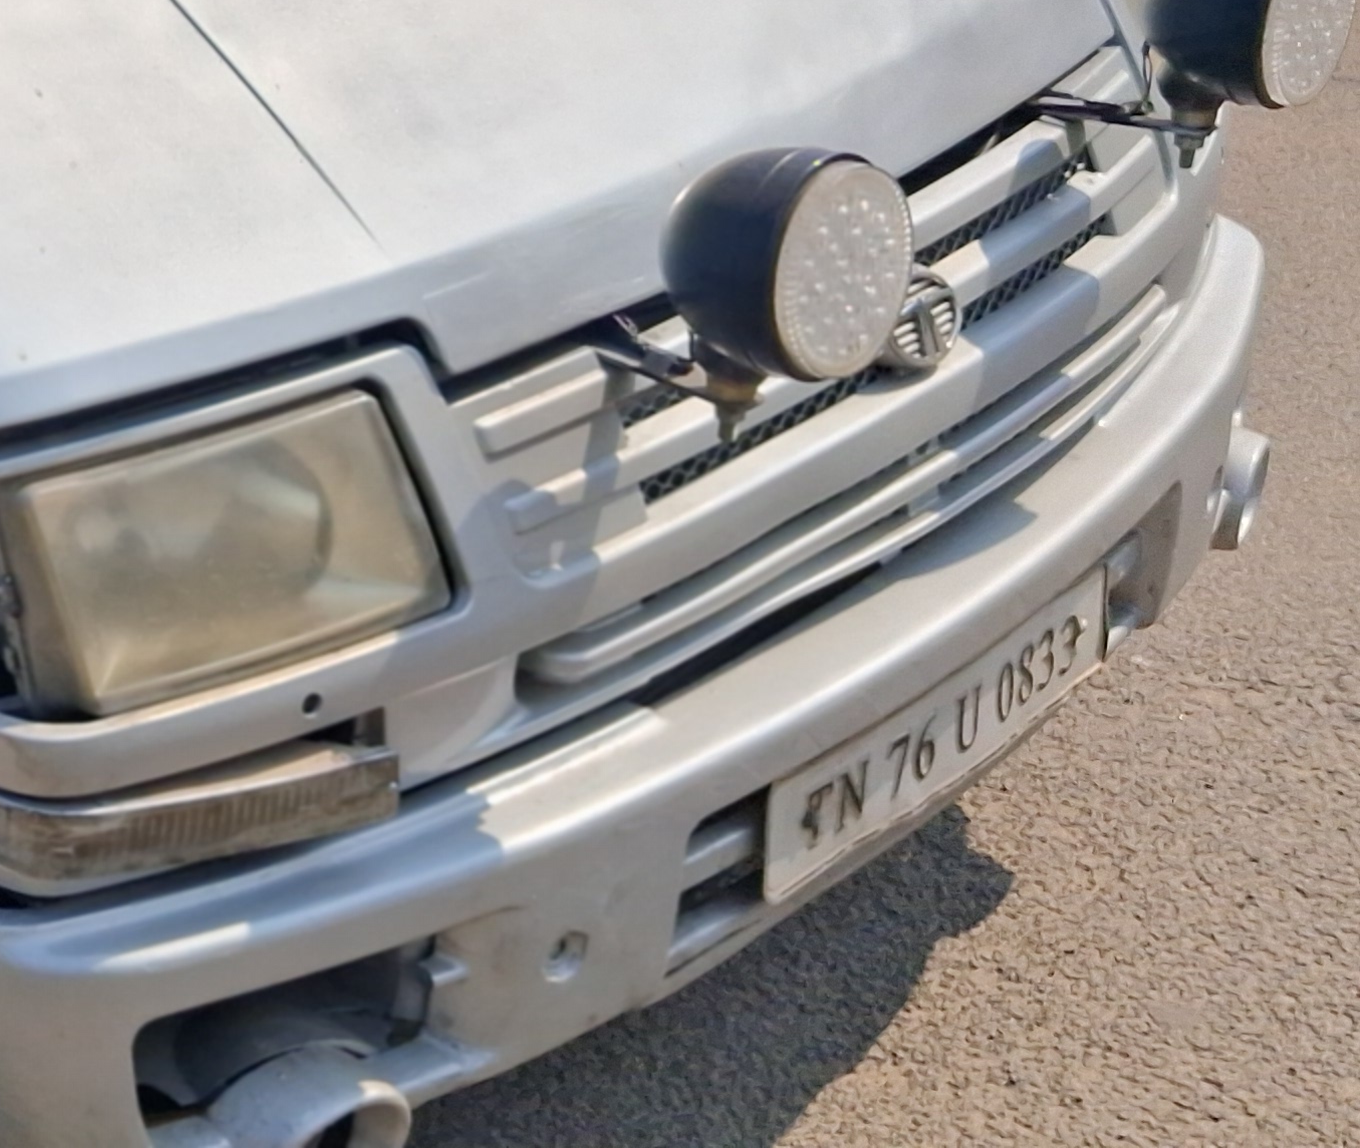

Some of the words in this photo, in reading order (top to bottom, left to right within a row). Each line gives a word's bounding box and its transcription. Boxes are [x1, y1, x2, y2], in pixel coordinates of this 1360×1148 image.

[800, 758, 871, 850] TN
[885, 706, 937, 799] 76
[956, 682, 983, 754] U
[996, 614, 1085, 723] 0833
